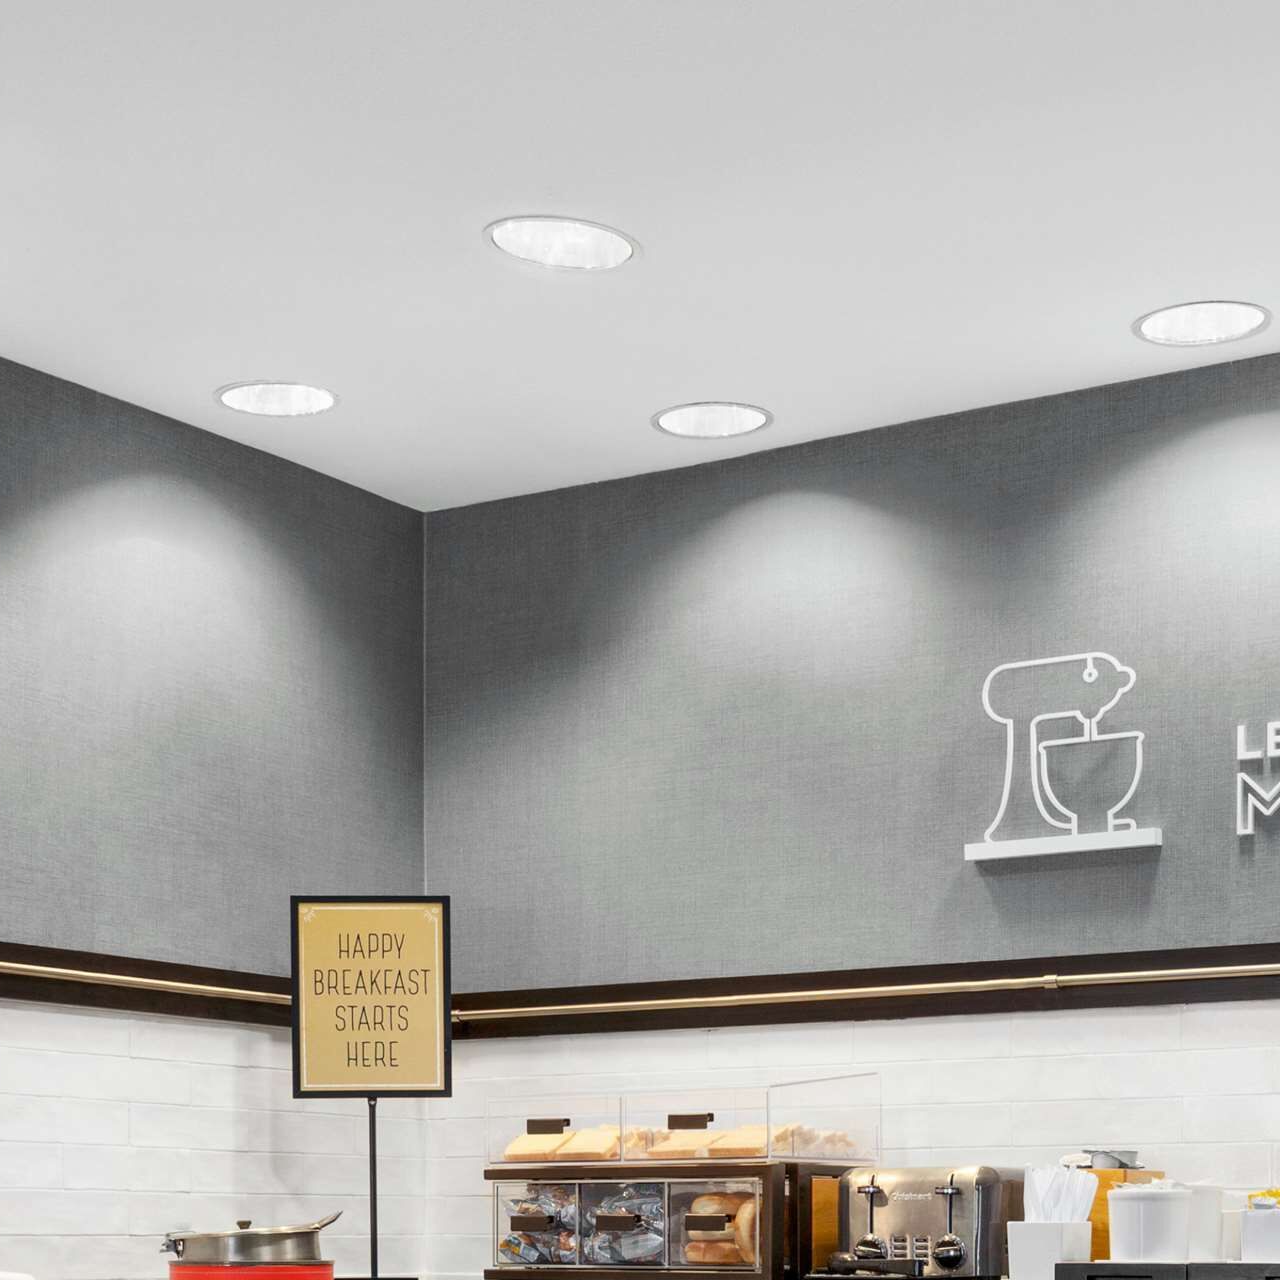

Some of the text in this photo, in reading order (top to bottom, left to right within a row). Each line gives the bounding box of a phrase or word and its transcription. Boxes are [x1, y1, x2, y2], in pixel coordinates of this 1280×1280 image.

[338, 933, 406, 959] HAPPY
[313, 969, 431, 996] BREAKFAST
[335, 1005, 409, 1032] STARTS
[346, 1041, 400, 1068] HERE
